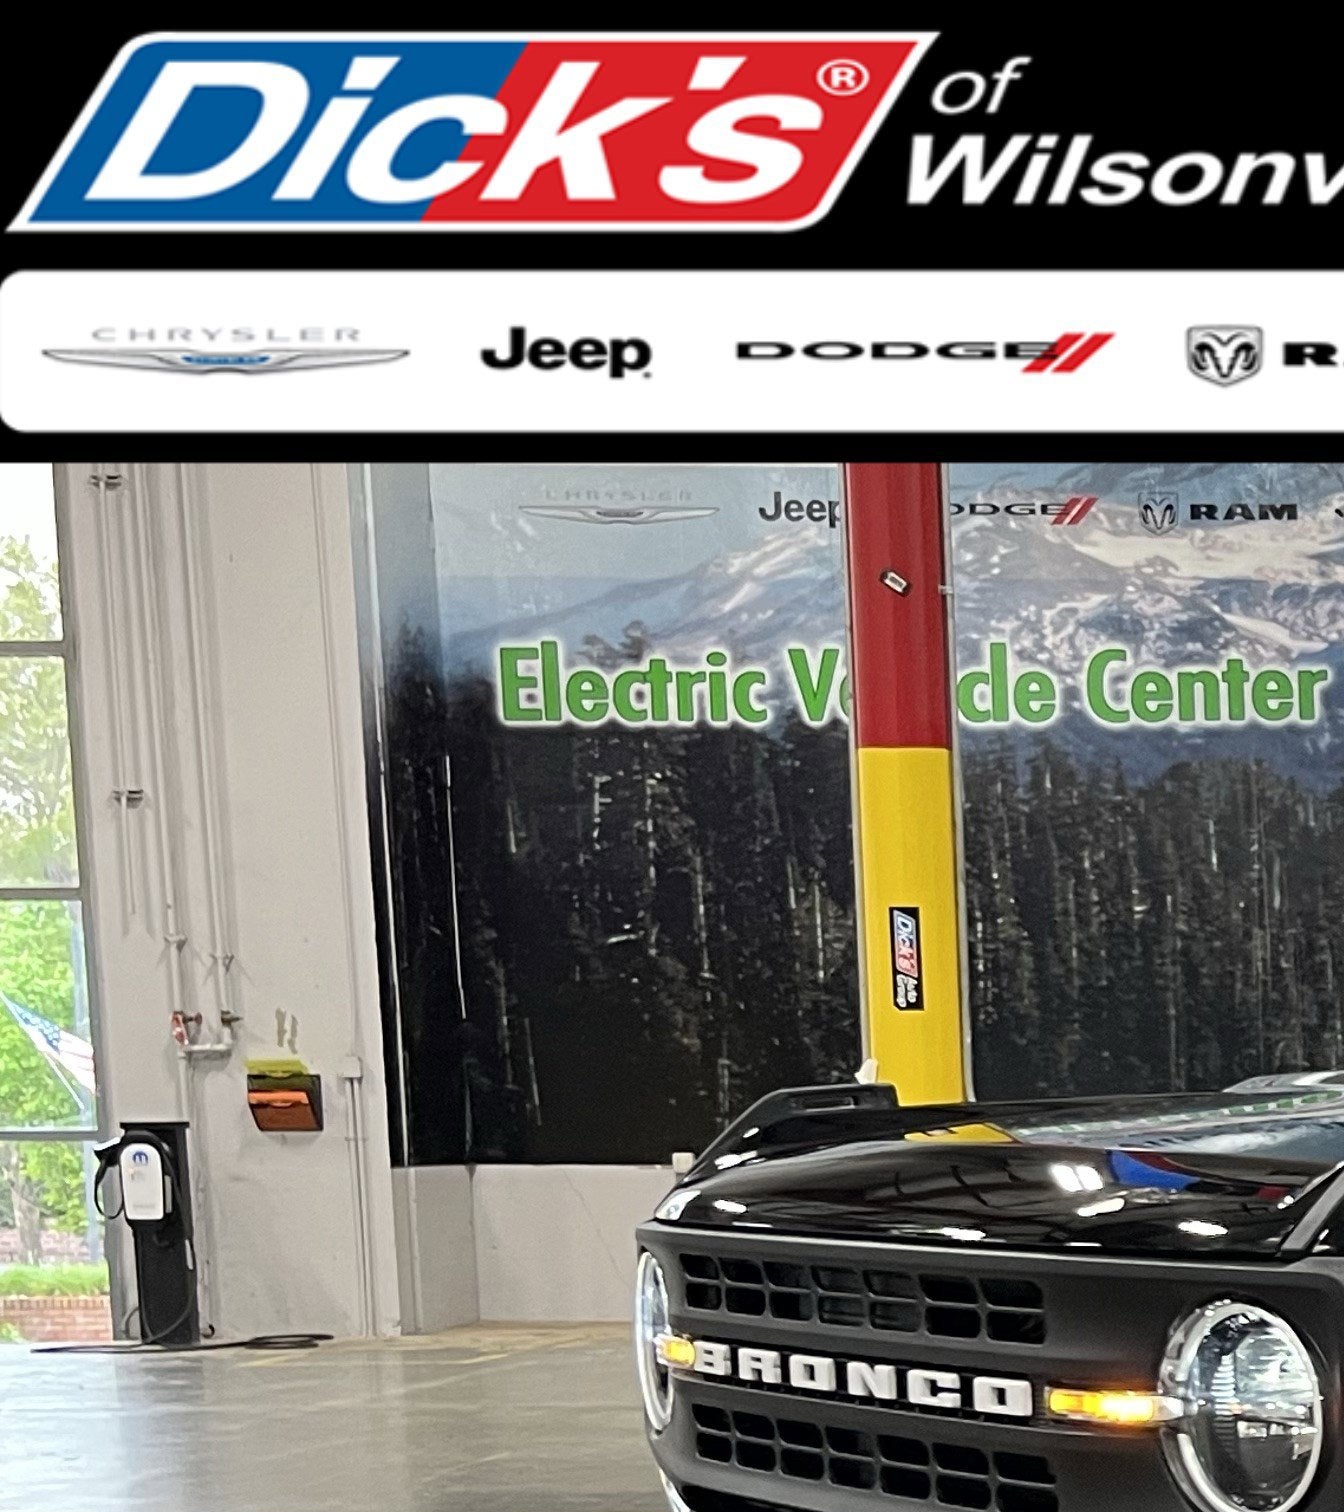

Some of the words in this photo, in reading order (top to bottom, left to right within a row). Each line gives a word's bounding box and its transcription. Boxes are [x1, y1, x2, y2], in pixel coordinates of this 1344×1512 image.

[1190, 503, 1298, 521] RAM
[499, 640, 768, 722] Electric
[787, 642, 1056, 722] Vcle
[1086, 648, 1328, 723] Center
[692, 1340, 1034, 1418] BRONCO
